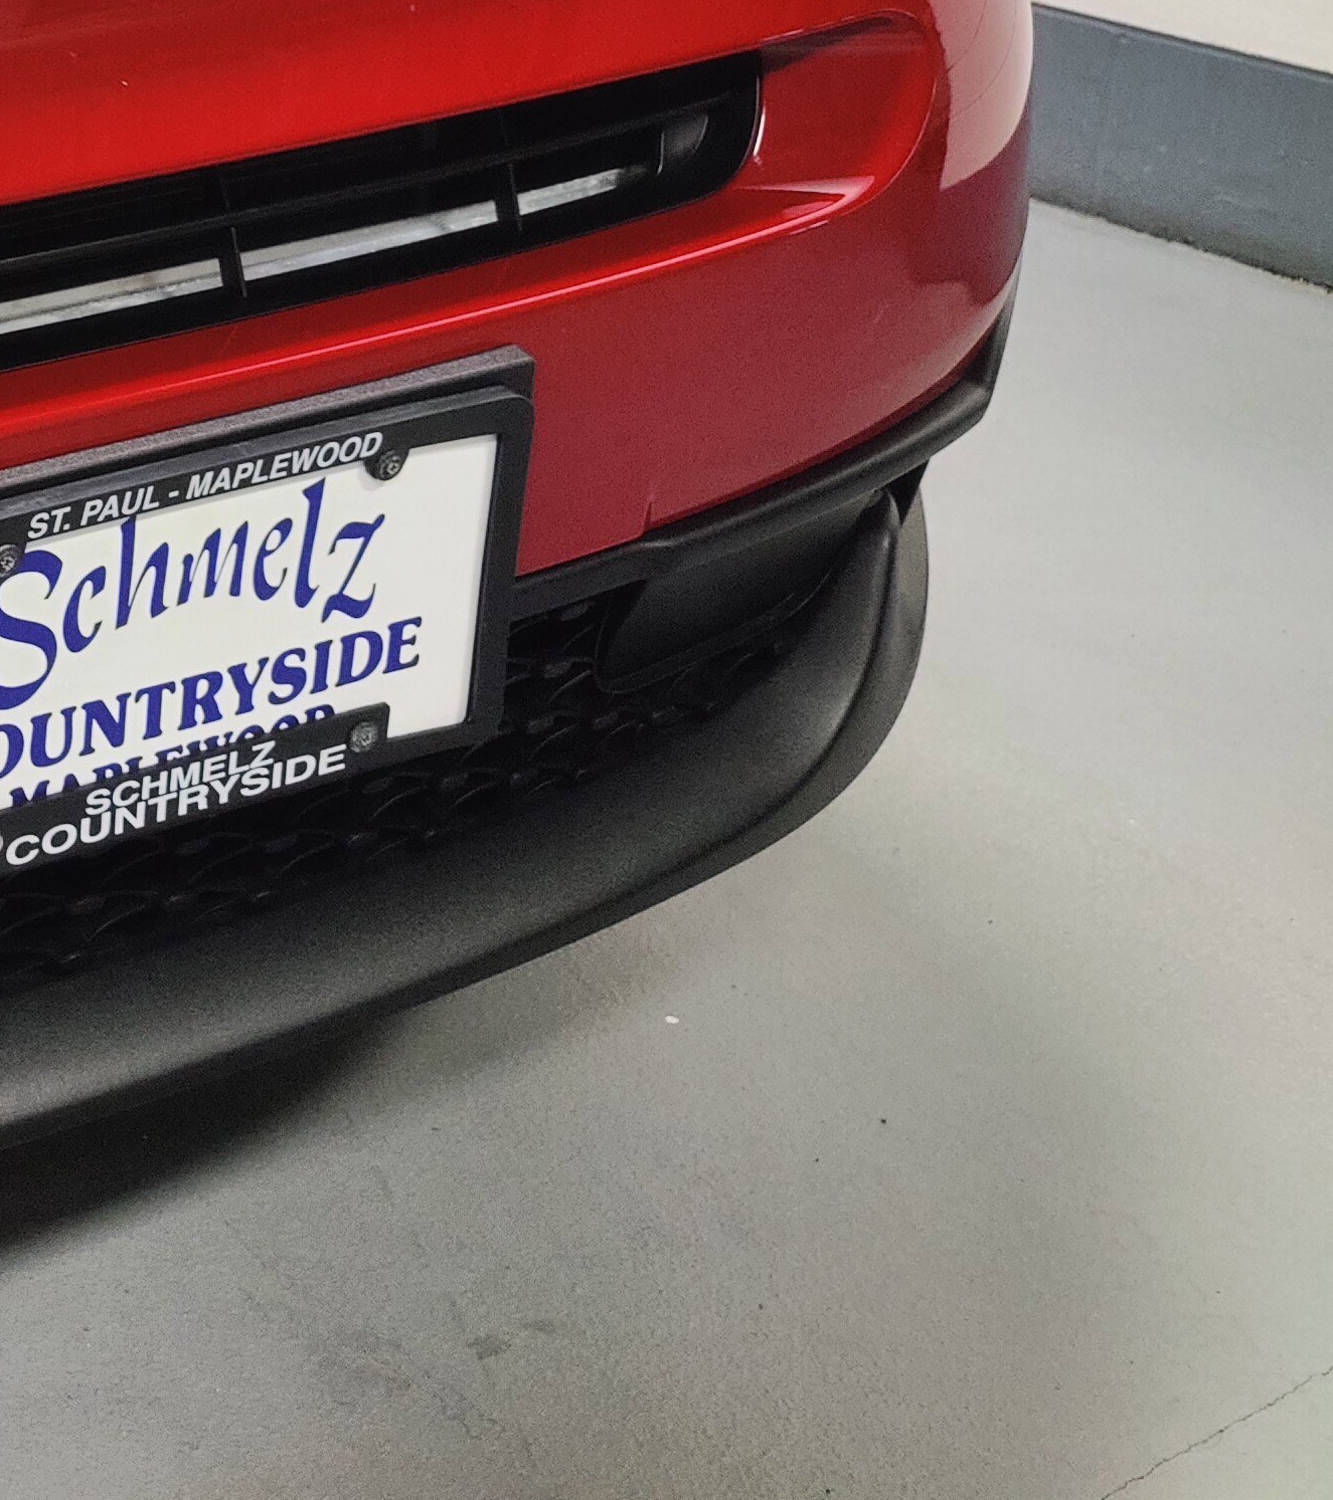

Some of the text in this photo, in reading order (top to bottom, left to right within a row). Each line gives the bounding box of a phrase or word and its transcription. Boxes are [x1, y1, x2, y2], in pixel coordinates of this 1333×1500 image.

[27, 432, 383, 539] ST. PAUL - MAPLEWOOD
[6, 744, 347, 866] COUNTRYSIDE
[85, 741, 276, 816] SCHMELZ
